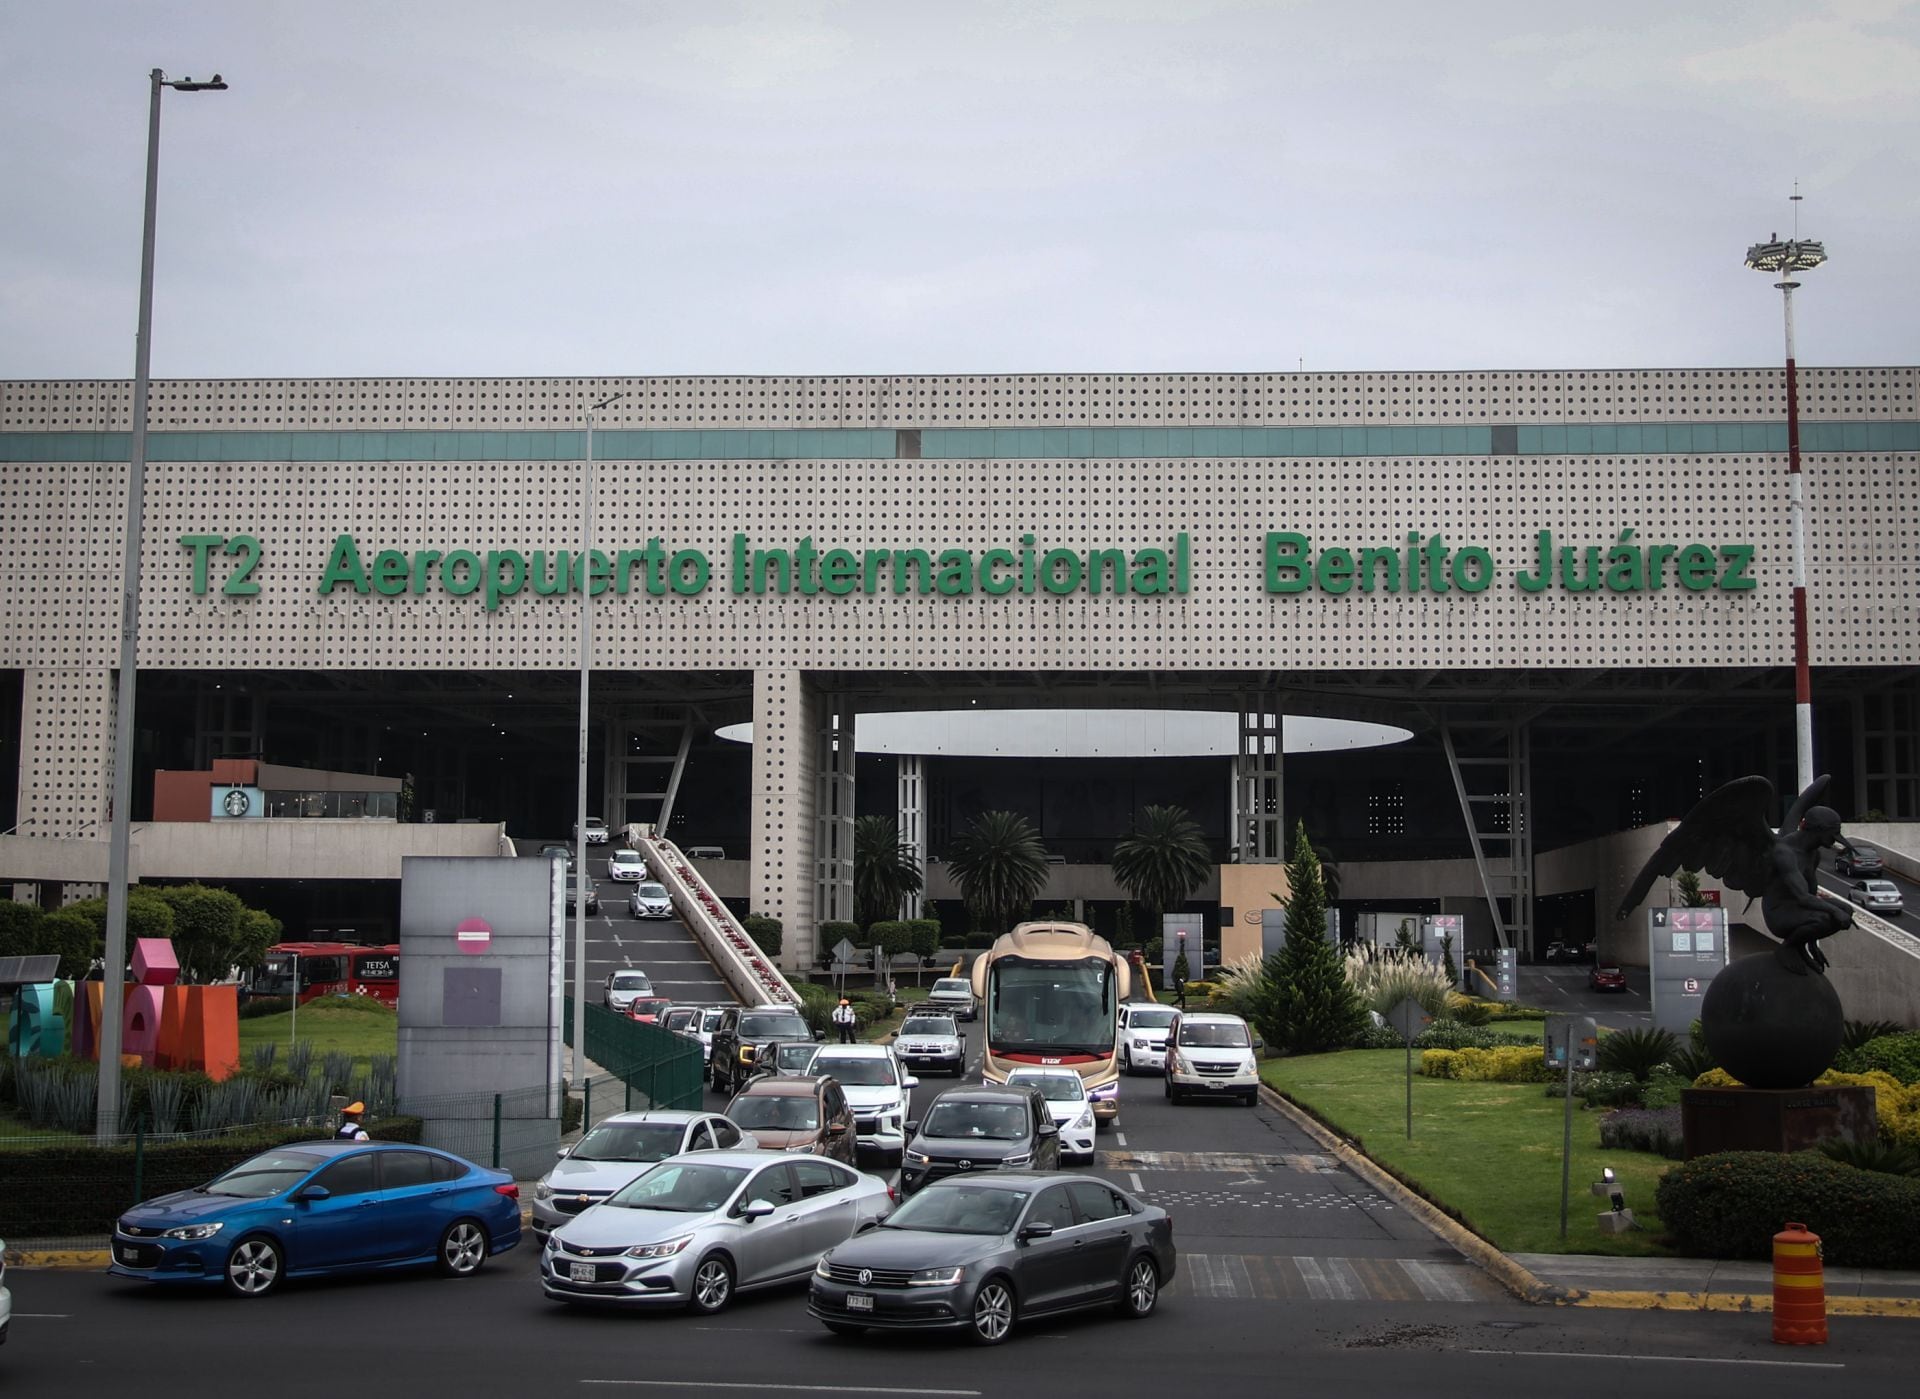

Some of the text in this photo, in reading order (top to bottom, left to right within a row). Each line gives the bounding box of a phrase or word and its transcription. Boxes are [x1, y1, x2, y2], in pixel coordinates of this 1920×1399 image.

[181, 528, 1757, 611] T2 Aeropuerto Internacional Benito Juárez
[365, 961, 390, 970] TETSA
